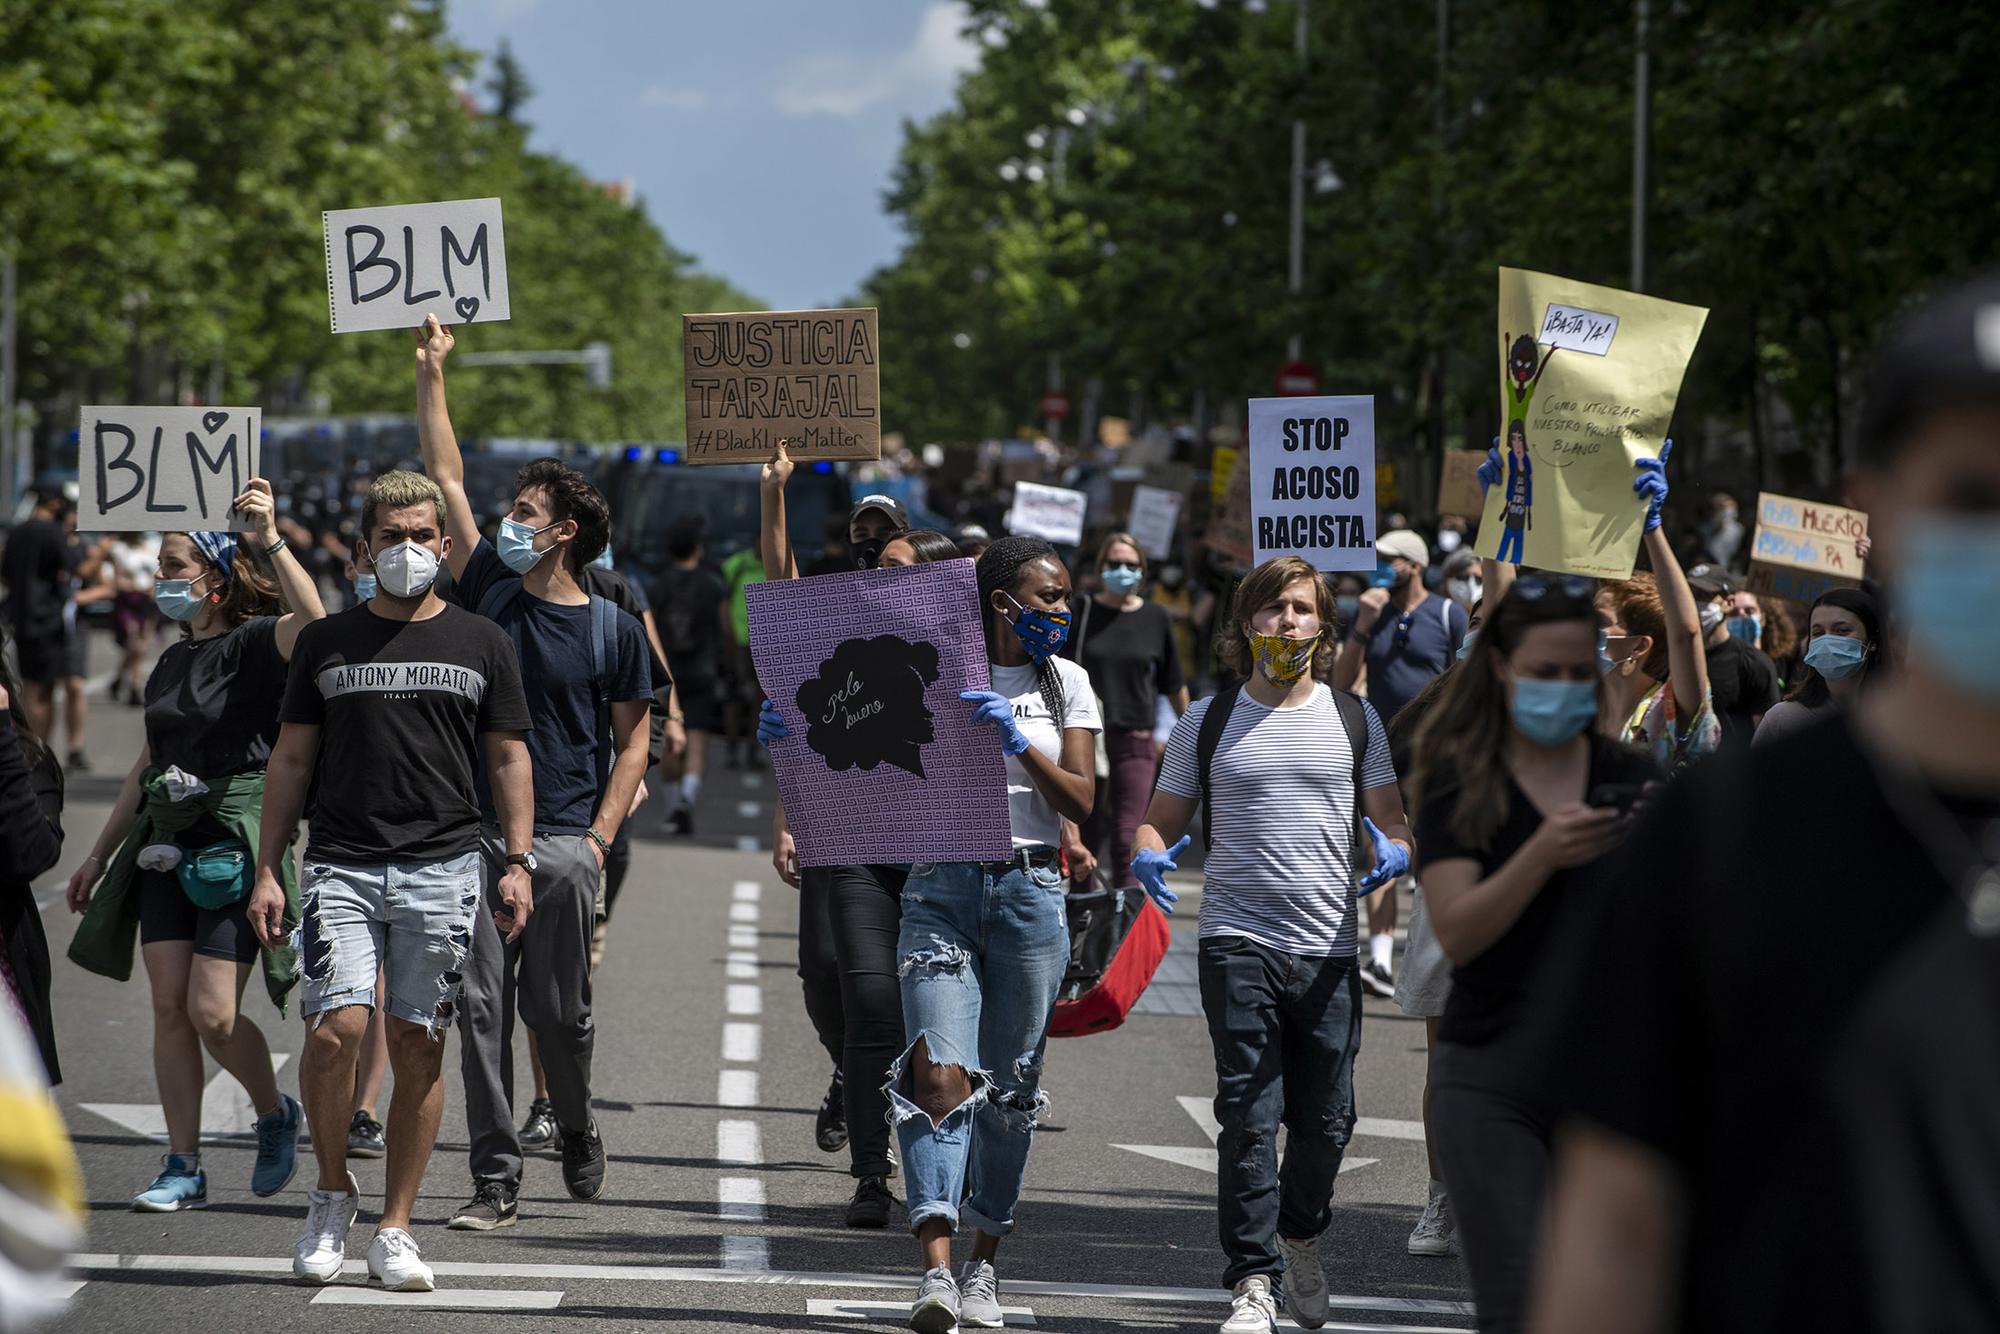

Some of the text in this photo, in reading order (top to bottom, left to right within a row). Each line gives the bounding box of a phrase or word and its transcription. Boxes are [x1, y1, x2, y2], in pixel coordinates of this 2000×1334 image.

[345, 222, 490, 305] BLM
[691, 319, 874, 367] JUSTICIA
[1582, 319, 1611, 342] YA!
[691, 375, 875, 419] TARAJAL
[1282, 417, 1349, 451] STOP
[1552, 439, 1601, 456] BLANCO
[1272, 466, 1360, 500] ACOSO
[1258, 514, 1373, 550] RACISTA.
[1801, 506, 1864, 538] MUERTO
[1825, 544, 1844, 569] PA
[336, 666, 468, 691] ANTONY MORATO
